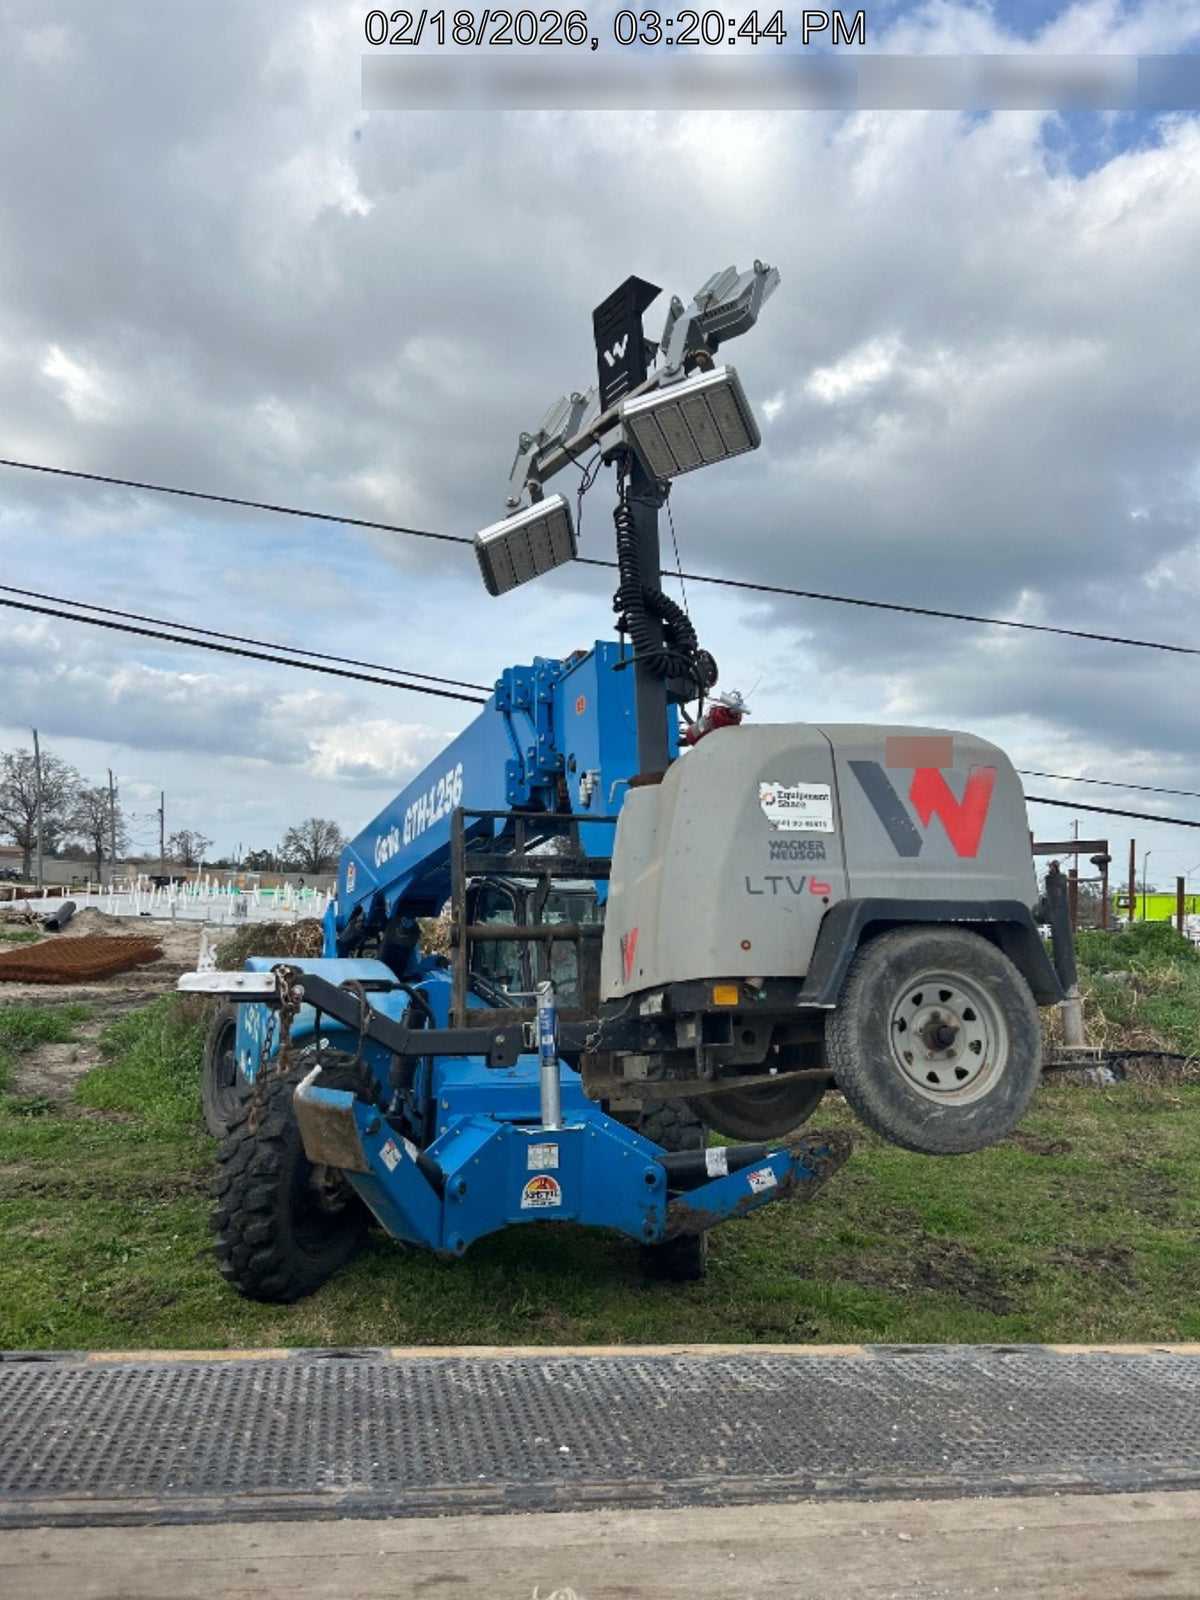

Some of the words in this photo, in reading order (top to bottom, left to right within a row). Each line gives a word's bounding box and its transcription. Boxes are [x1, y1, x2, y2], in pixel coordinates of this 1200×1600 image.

[768, 840, 825, 851] WACKER
[769, 850, 826, 861] NEUSON
[745, 875, 831, 896] LTV6
